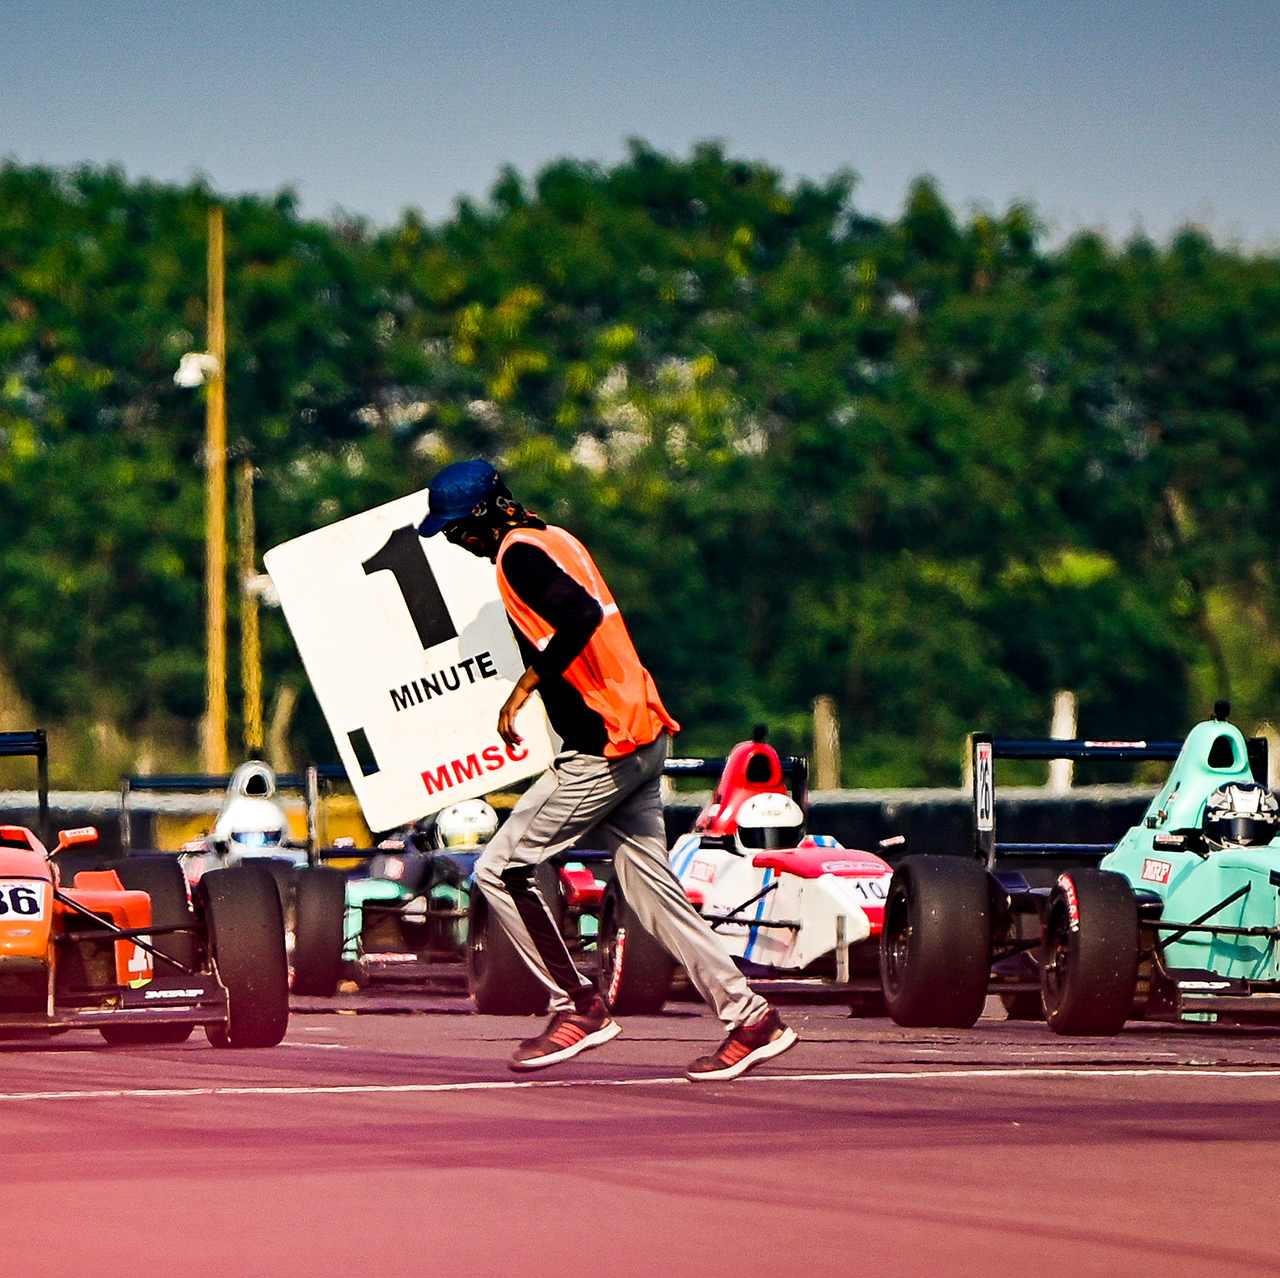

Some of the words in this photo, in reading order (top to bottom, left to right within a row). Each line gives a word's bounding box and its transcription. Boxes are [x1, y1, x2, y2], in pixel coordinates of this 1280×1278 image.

[361, 522, 459, 650] 1
[389, 651, 498, 712] MINUTE
[855, 882, 887, 899] 10
